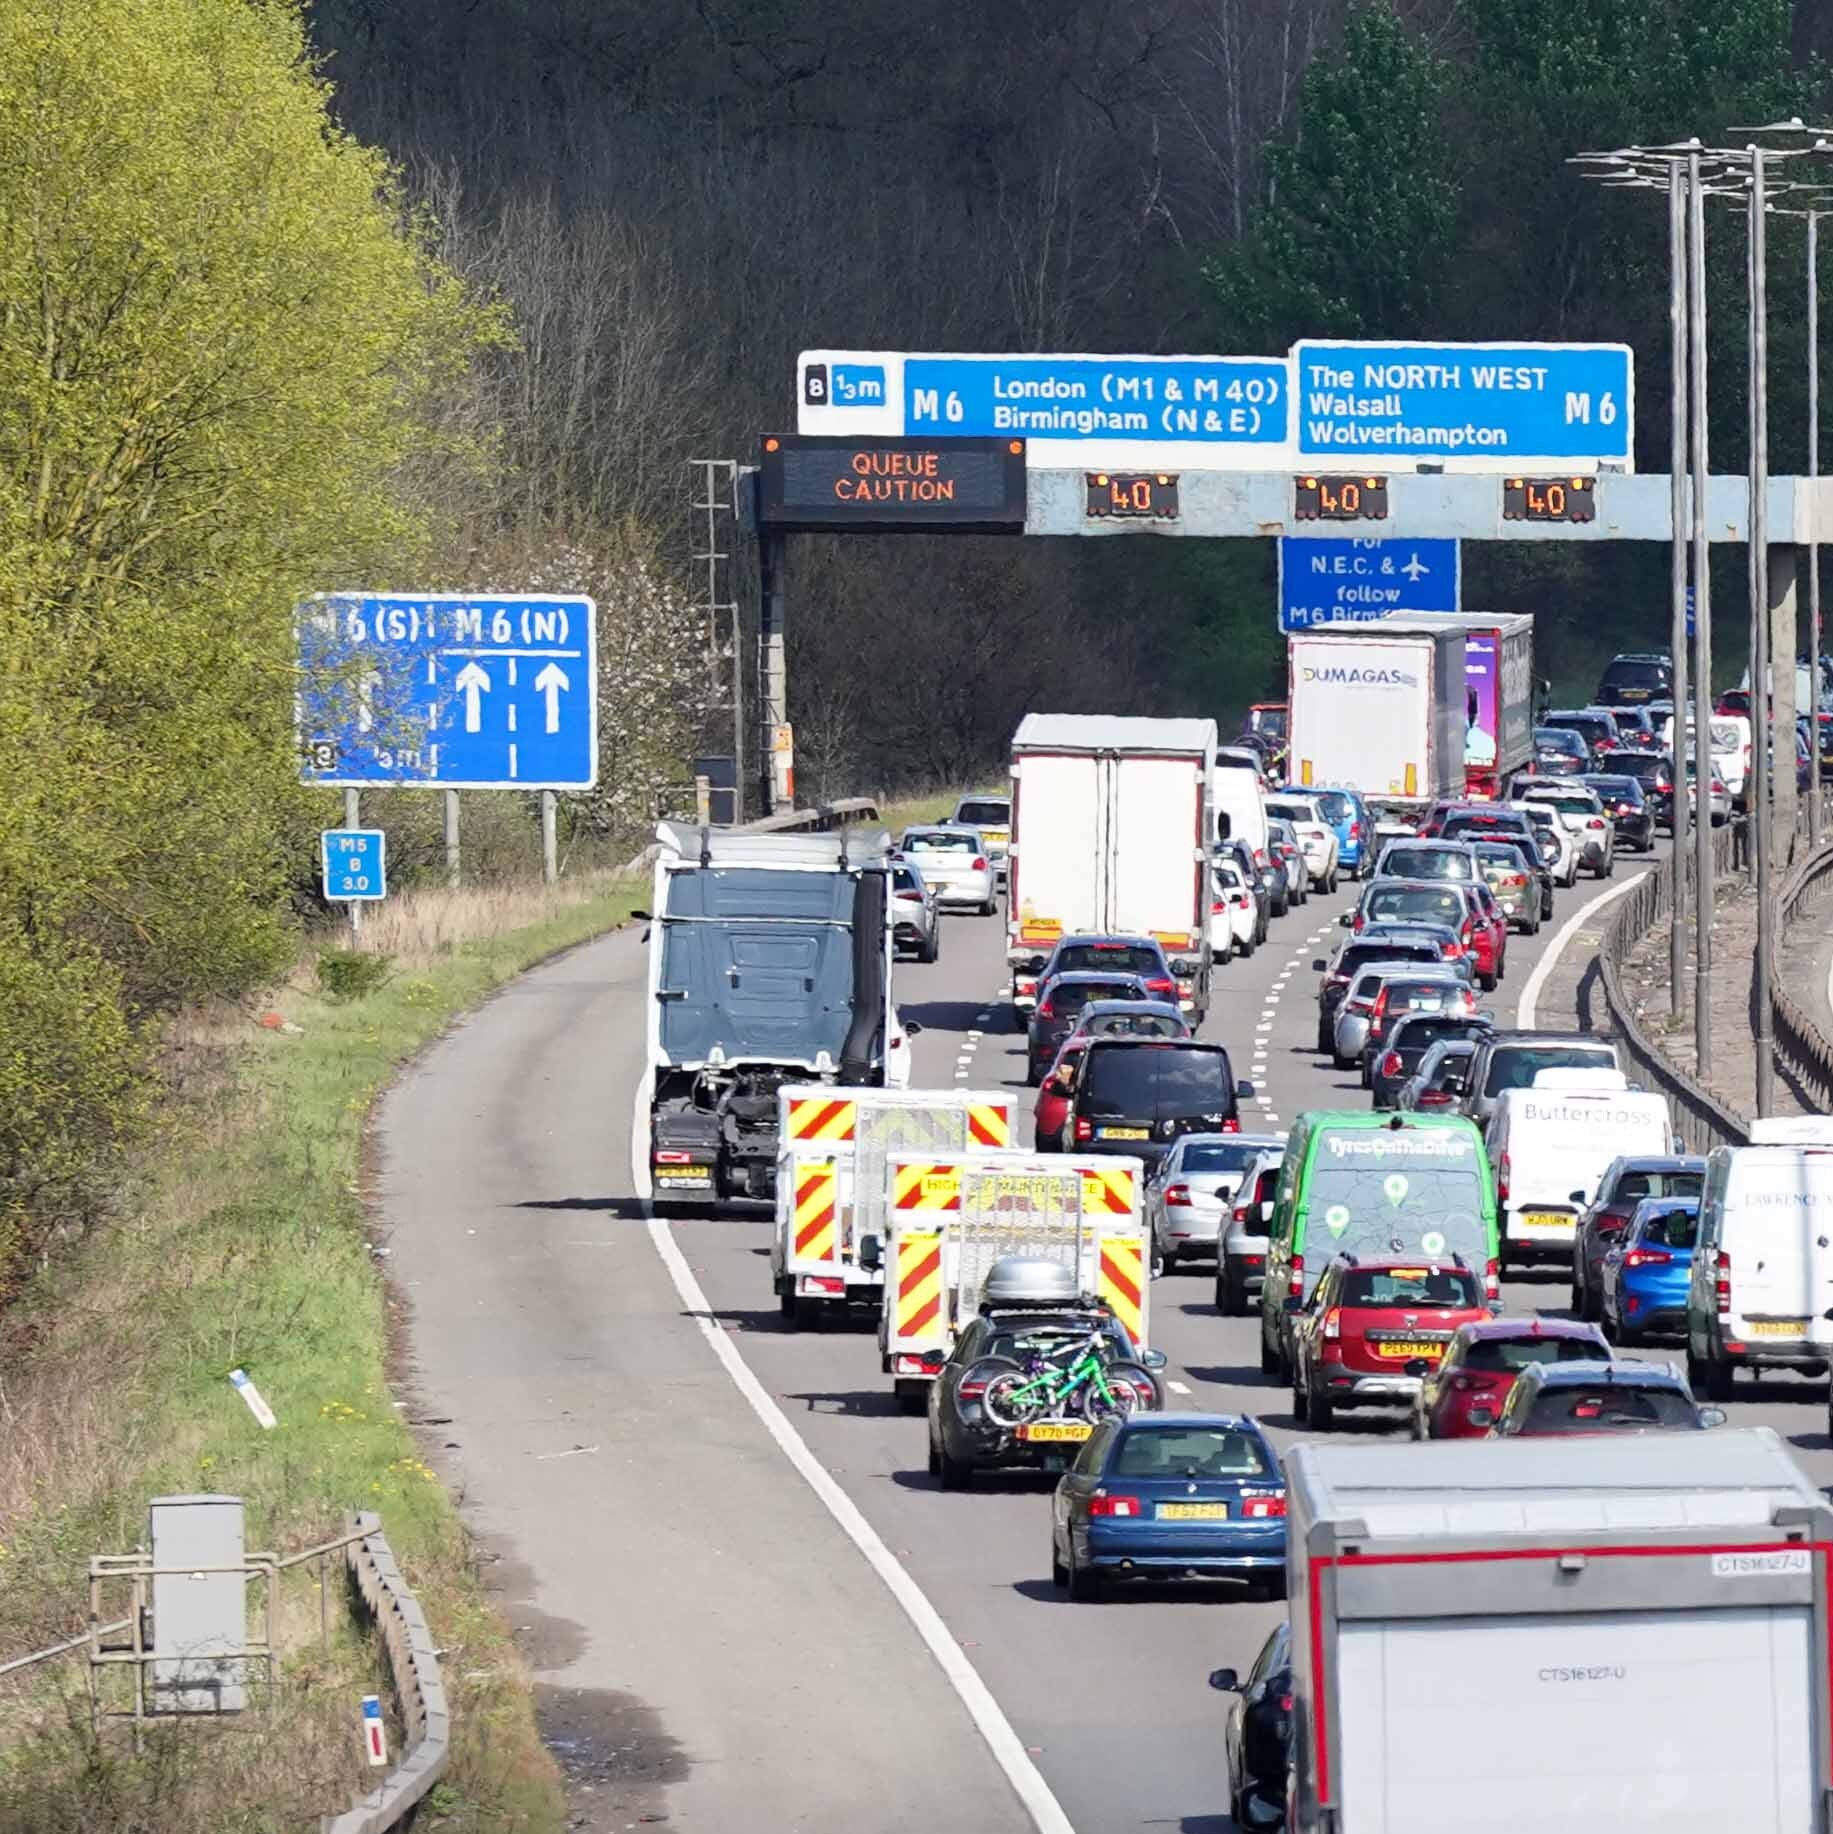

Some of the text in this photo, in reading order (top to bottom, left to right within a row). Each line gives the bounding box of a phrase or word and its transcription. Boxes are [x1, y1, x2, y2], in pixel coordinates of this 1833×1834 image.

[809, 379, 823, 396] 8
[994, 375, 1086, 399] London
[1165, 377, 1183, 400] &
[1308, 365, 1548, 390] The NORTH WEST
[1309, 393, 1402, 416] Walsall
[994, 406, 1148, 433] Birmingham
[1308, 421, 1508, 448] Wolverhampton
[852, 453, 939, 476] QUEUE
[834, 479, 955, 500] CAUTION
[1111, 481, 1151, 509] 40
[1320, 483, 1360, 512] 40
[1528, 485, 1566, 514] 40
[1311, 556, 1396, 575] N.E.C. &
[1337, 585, 1400, 603] follow
[374, 607, 420, 642] (S)
[521, 608, 570, 644] (N)
[341, 838, 367, 852] M5
[343, 876, 369, 891] 3.0
[1523, 1103, 1652, 1125] Buttercross
